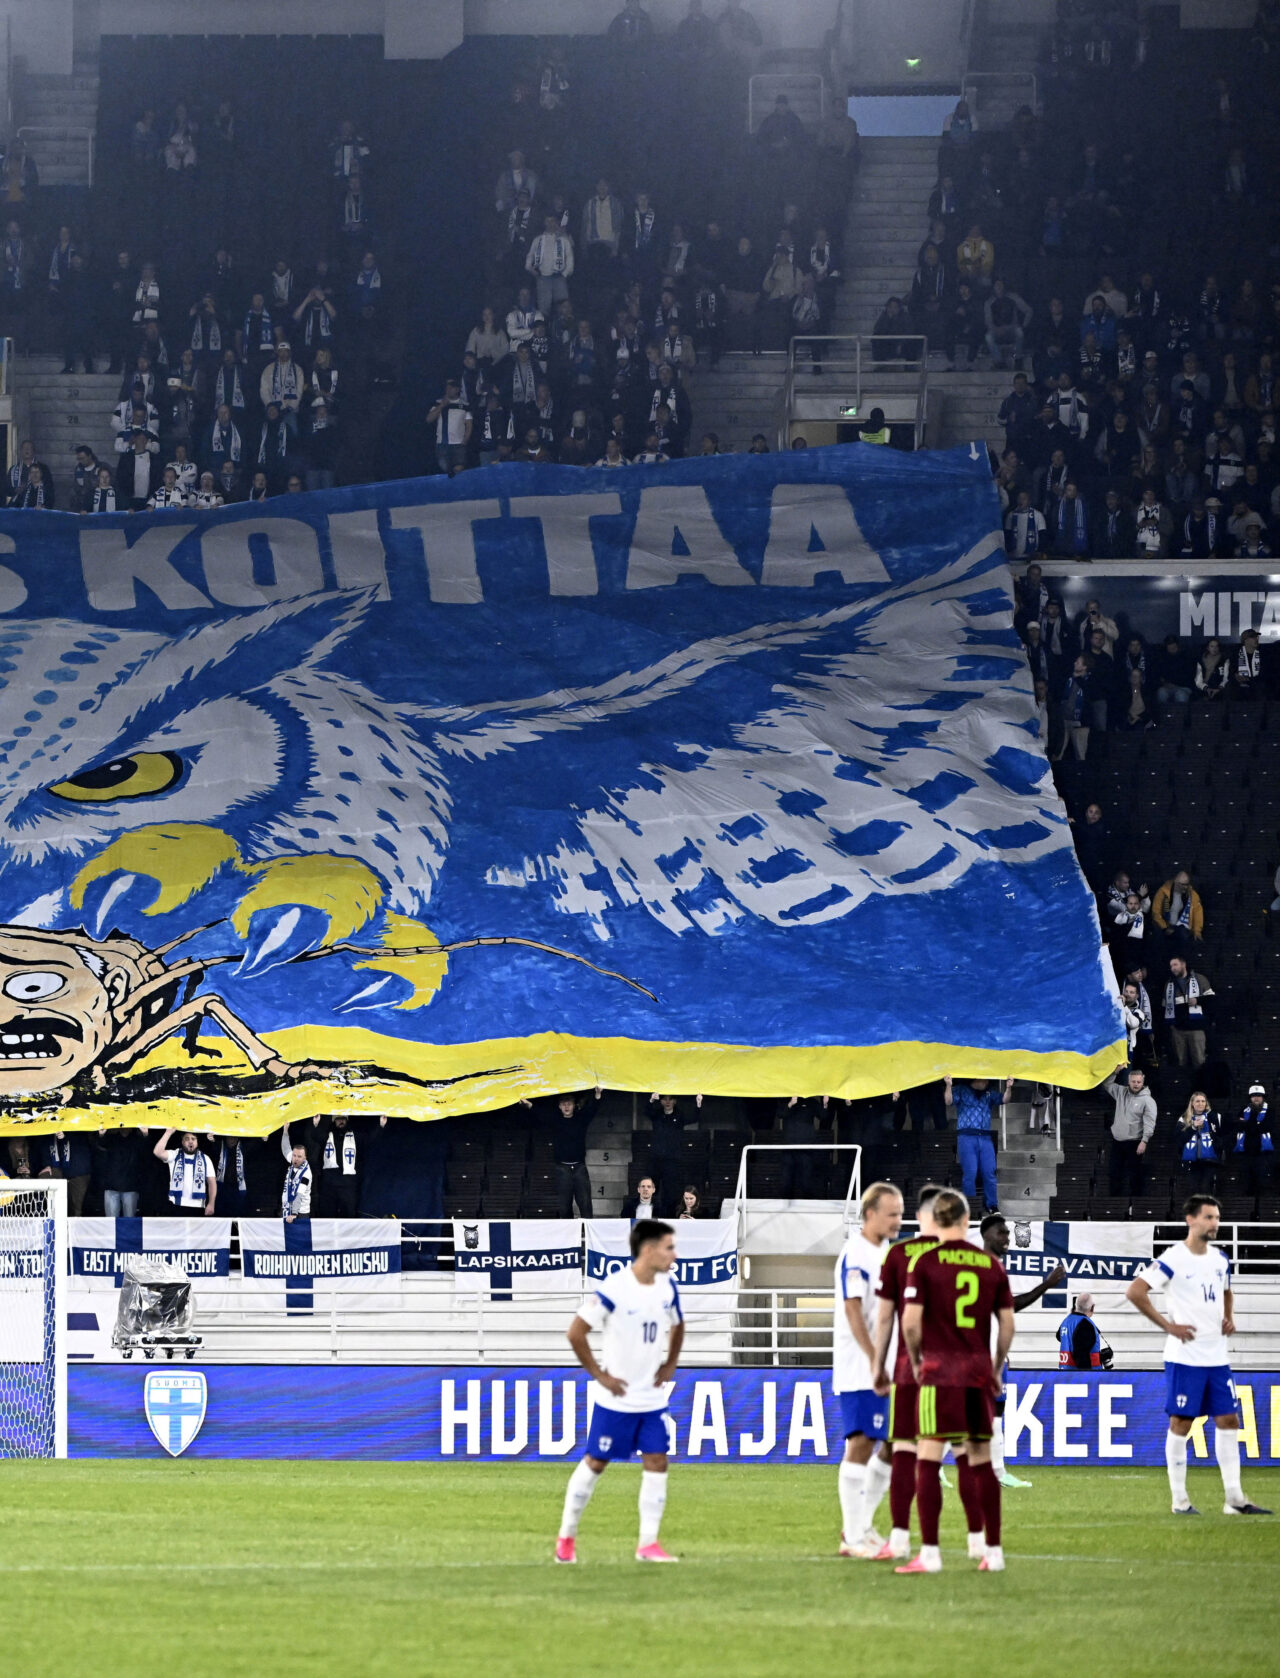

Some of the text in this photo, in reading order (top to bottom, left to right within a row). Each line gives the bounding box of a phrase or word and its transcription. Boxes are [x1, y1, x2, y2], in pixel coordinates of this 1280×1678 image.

[79, 484, 892, 610] KOITTAA
[84, 1251, 112, 1273] EAST
[254, 1249, 389, 1276] ROIHUVUOREN RUISKU
[457, 1252, 579, 1269] LAPSIKAARTI
[955, 1271, 980, 1329] 2
[1201, 1283, 1216, 1303] 14
[642, 1321, 658, 1344] 10
